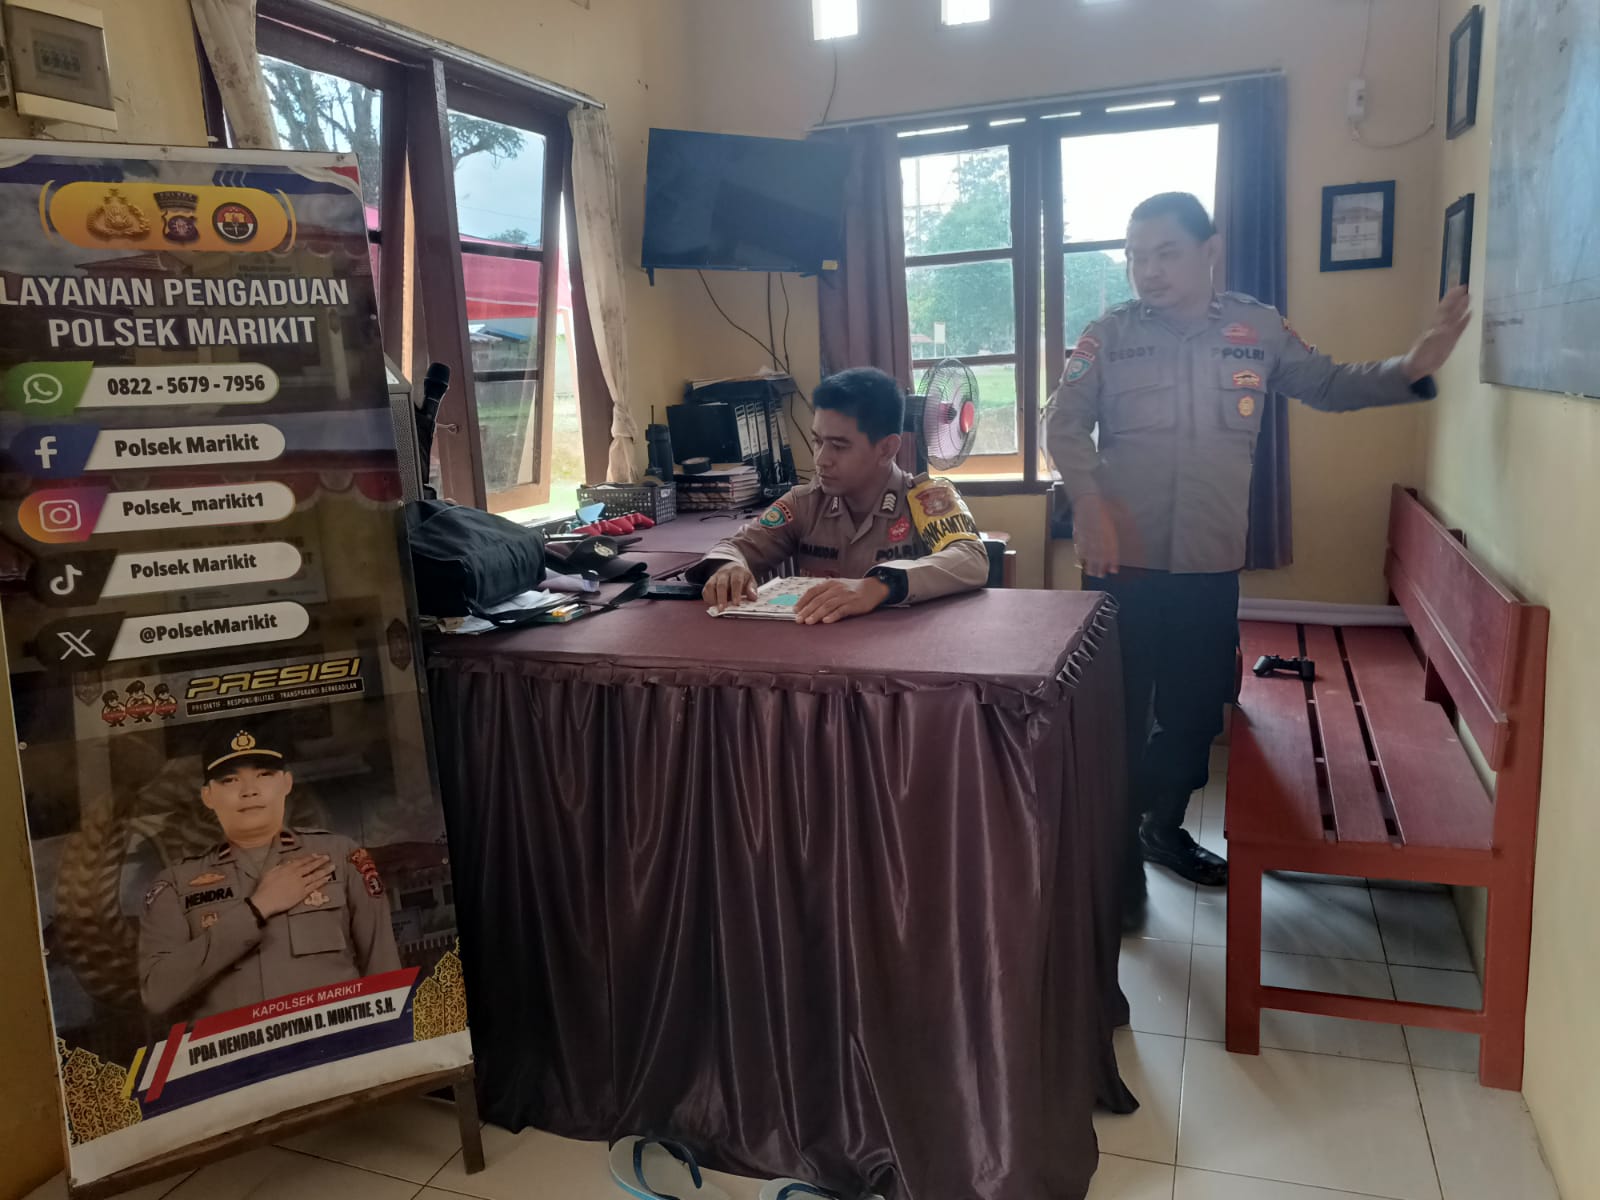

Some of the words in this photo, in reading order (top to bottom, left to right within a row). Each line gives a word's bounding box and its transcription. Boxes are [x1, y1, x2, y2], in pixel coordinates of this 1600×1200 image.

[0, 276, 155, 306] LAYANAN
[164, 278, 349, 306] PENGADUAN
[49, 318, 180, 347] POLSEK
[188, 316, 315, 346] MARIKIT
[1222, 347, 1264, 361] POLRI
[107, 377, 152, 395] 0822
[167, 376, 210, 393] 5679
[223, 374, 265, 392] 7956
[115, 437, 182, 457] Polsek
[186, 434, 259, 454] Marikit
[123, 492, 264, 516] Polsek_marikit1
[131, 559, 190, 579] Polsek
[193, 553, 257, 573] Marikit
[140, 614, 278, 644] @PolsekMarikit
[186, 657, 361, 699] PRESISI
[185, 886, 234, 909] HENDRA
[252, 996, 315, 1019] KAPOLSEK
[317, 982, 363, 1003] MARIKIT
[188, 1044, 218, 1066] IPDA
[219, 1031, 264, 1058] HENDRA
[376, 997, 397, 1016] S.H.
